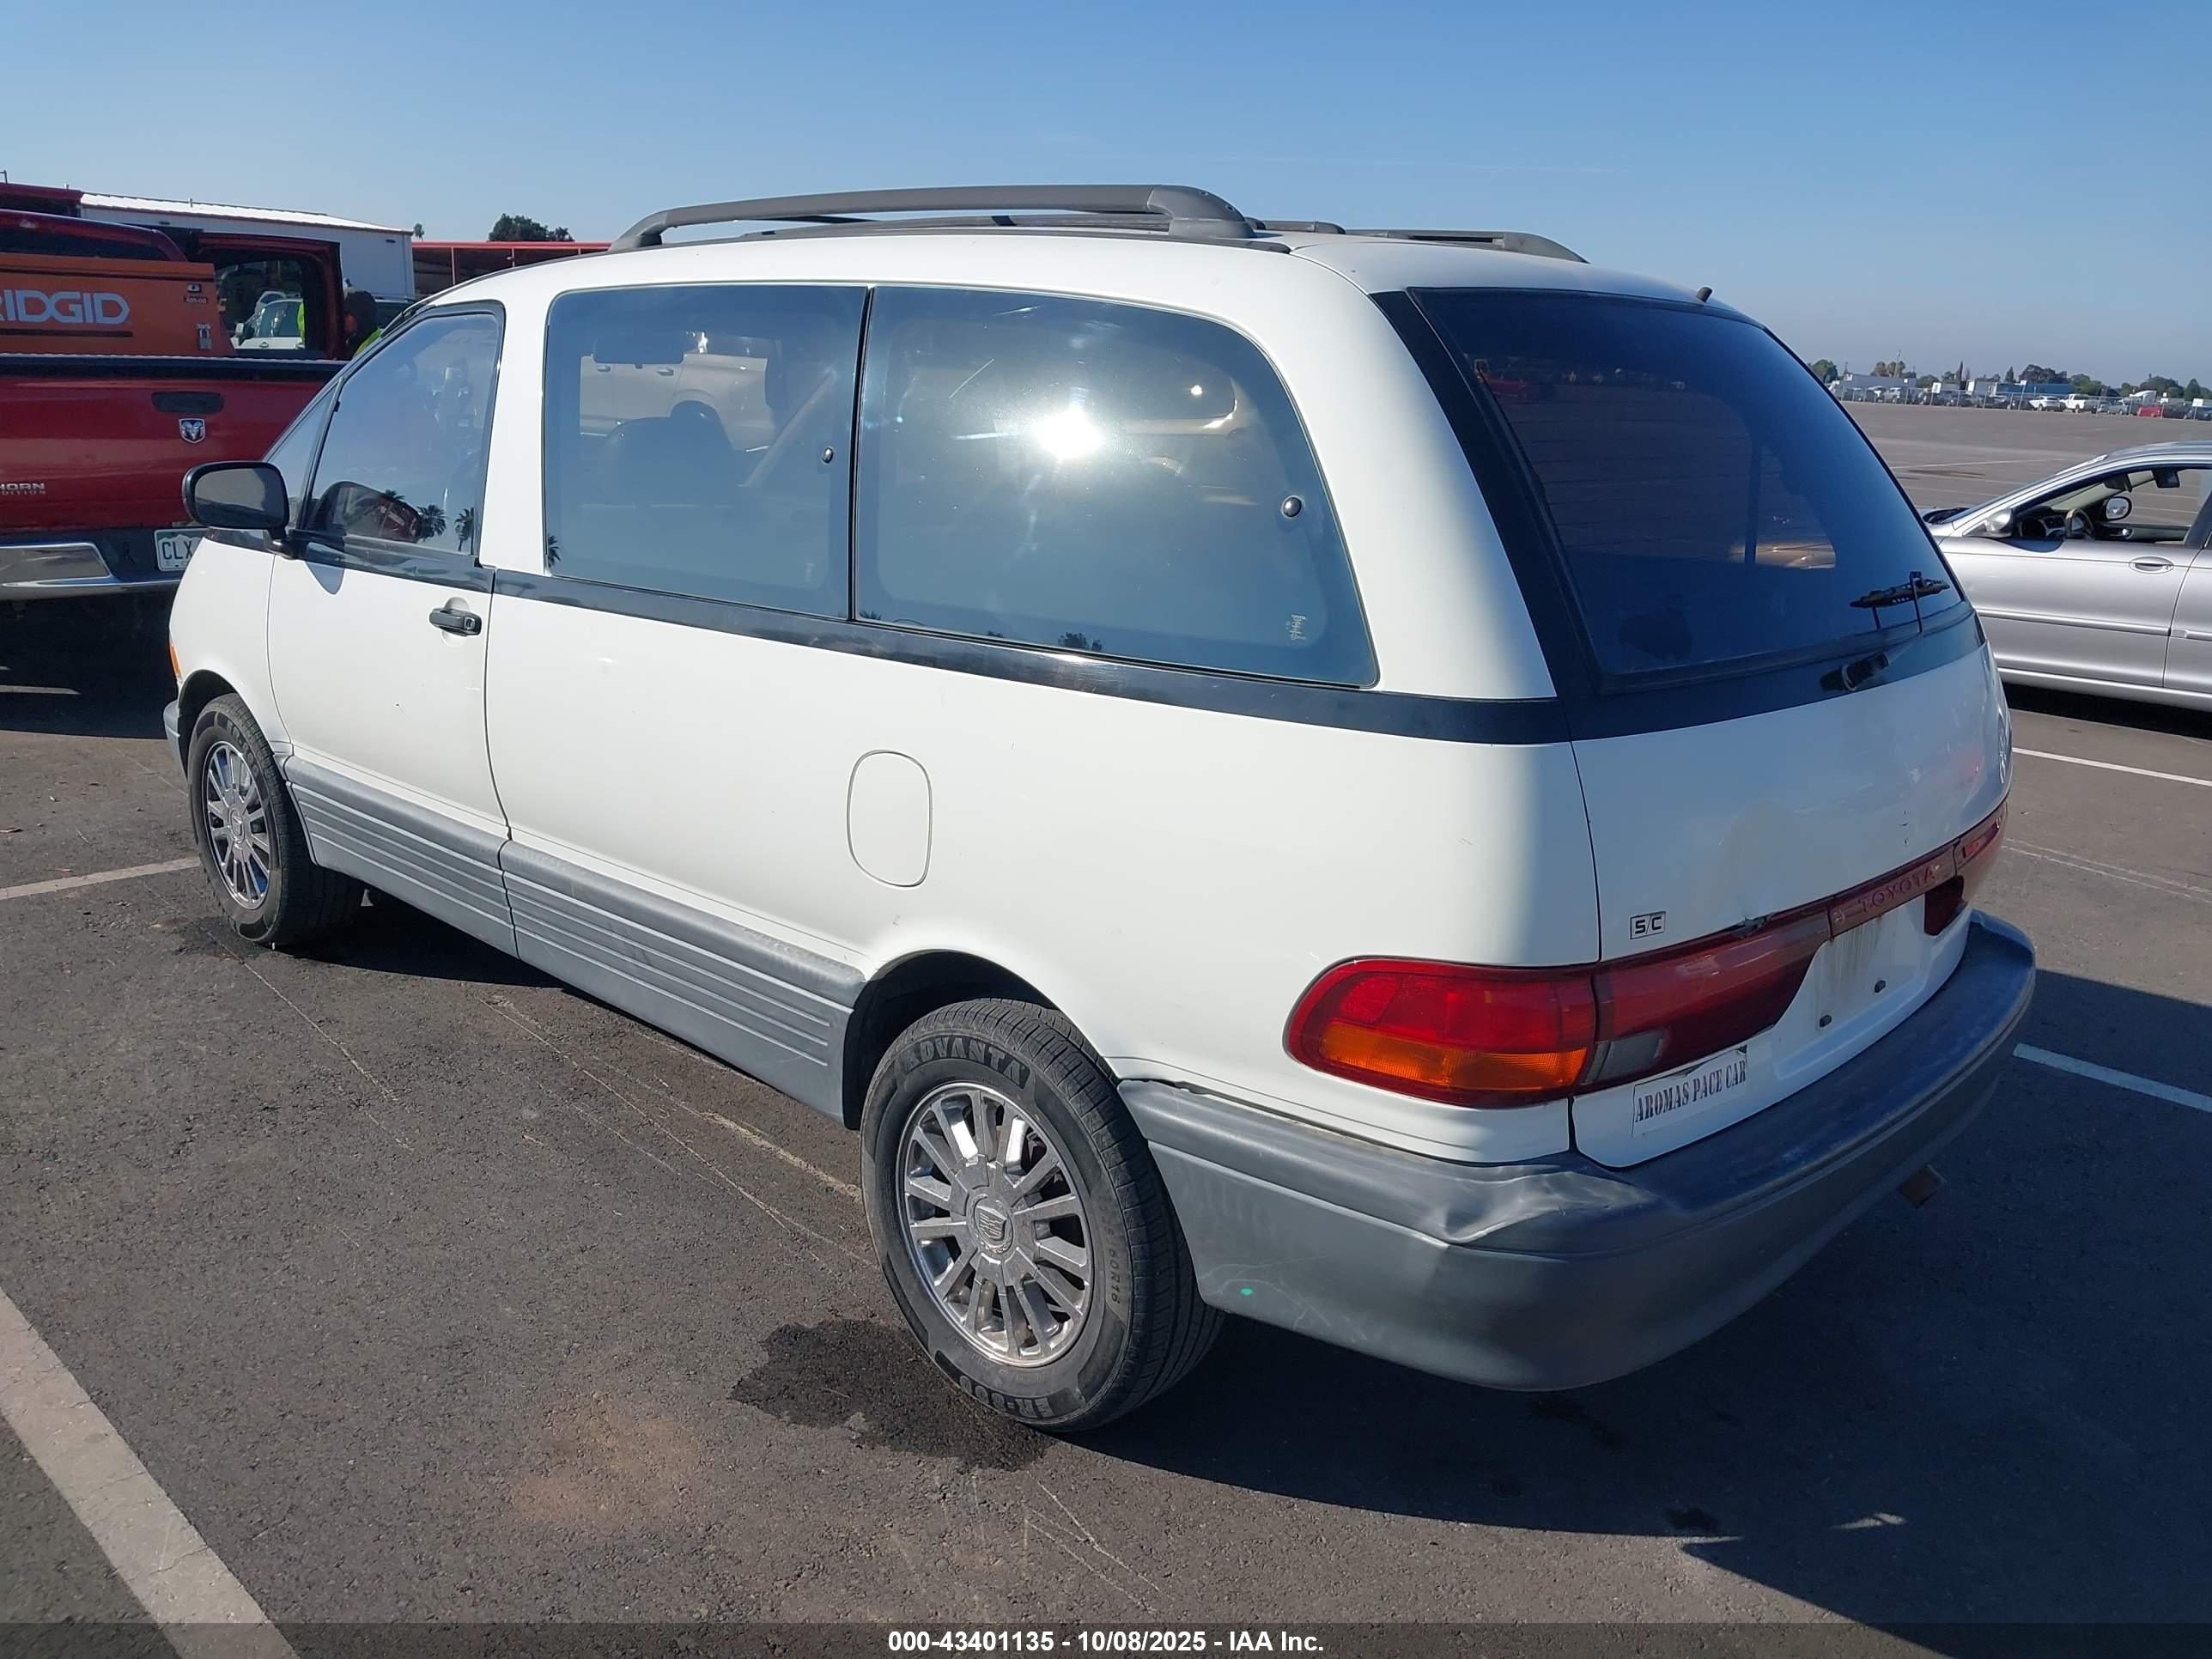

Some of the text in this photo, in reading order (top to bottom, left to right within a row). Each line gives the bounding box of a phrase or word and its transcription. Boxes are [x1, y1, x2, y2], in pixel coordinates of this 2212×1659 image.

[0, 289, 131, 325] IDGID
[161, 540, 193, 560] CLX
[1856, 866, 1936, 915] TOYOTA
[1634, 915, 1662, 935] S/C
[905, 1036, 1021, 1086] ADVANTA
[1634, 1059, 1747, 1123] AROMAS PACE CAR
